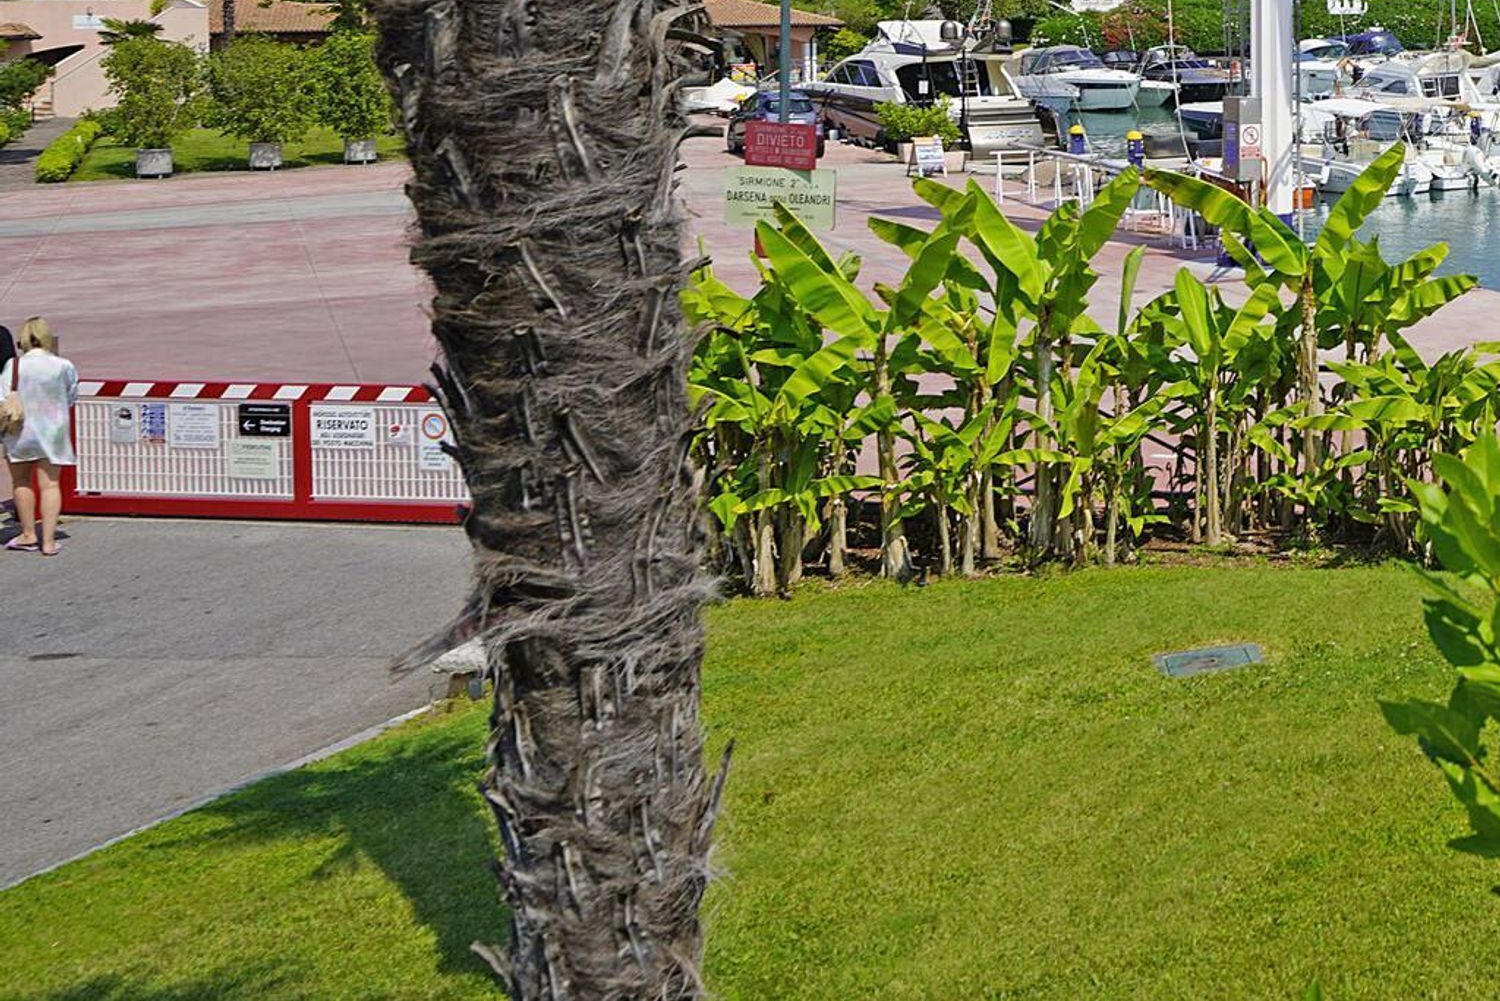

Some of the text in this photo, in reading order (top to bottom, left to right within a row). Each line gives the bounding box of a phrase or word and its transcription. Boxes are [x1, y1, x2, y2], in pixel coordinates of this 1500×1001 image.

[757, 133, 804, 148] DIVIETO
[726, 190, 767, 202] DARSENA
[789, 193, 831, 206] OLEANDRI
[317, 419, 368, 430] RISERVATO
